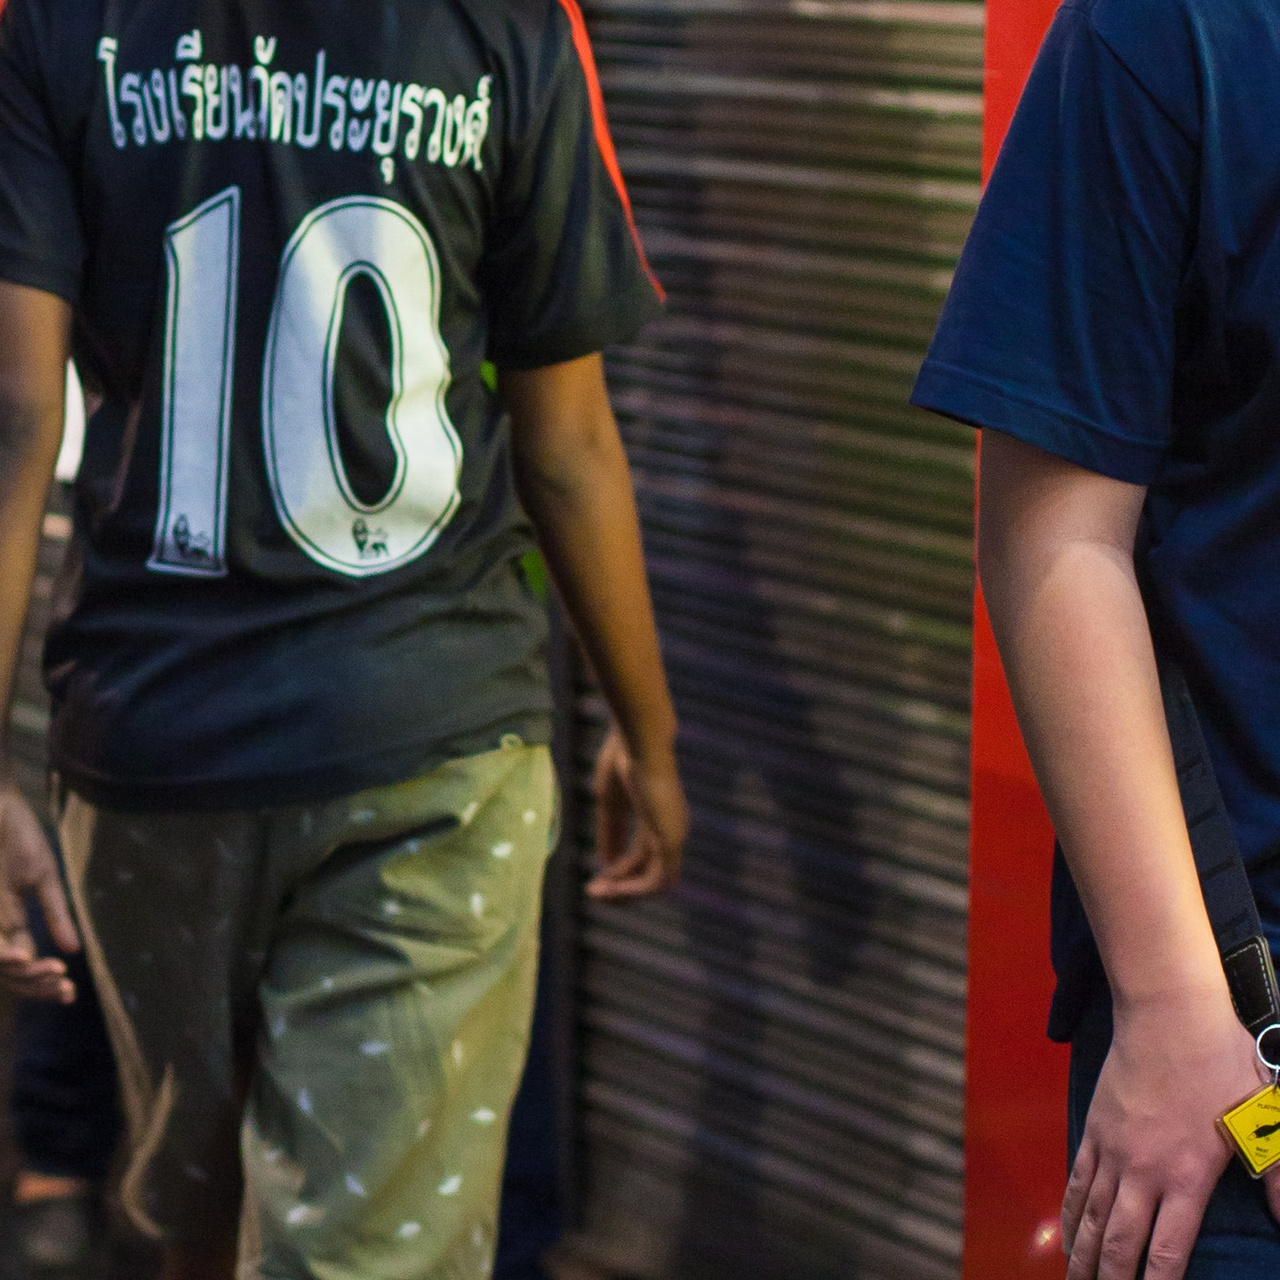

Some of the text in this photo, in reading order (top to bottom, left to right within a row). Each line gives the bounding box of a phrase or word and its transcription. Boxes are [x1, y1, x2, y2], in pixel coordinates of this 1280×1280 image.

[96, 28, 494, 184] โรงเรียนวัดประยุรวงศ์
[146, 184, 464, 578] 10
